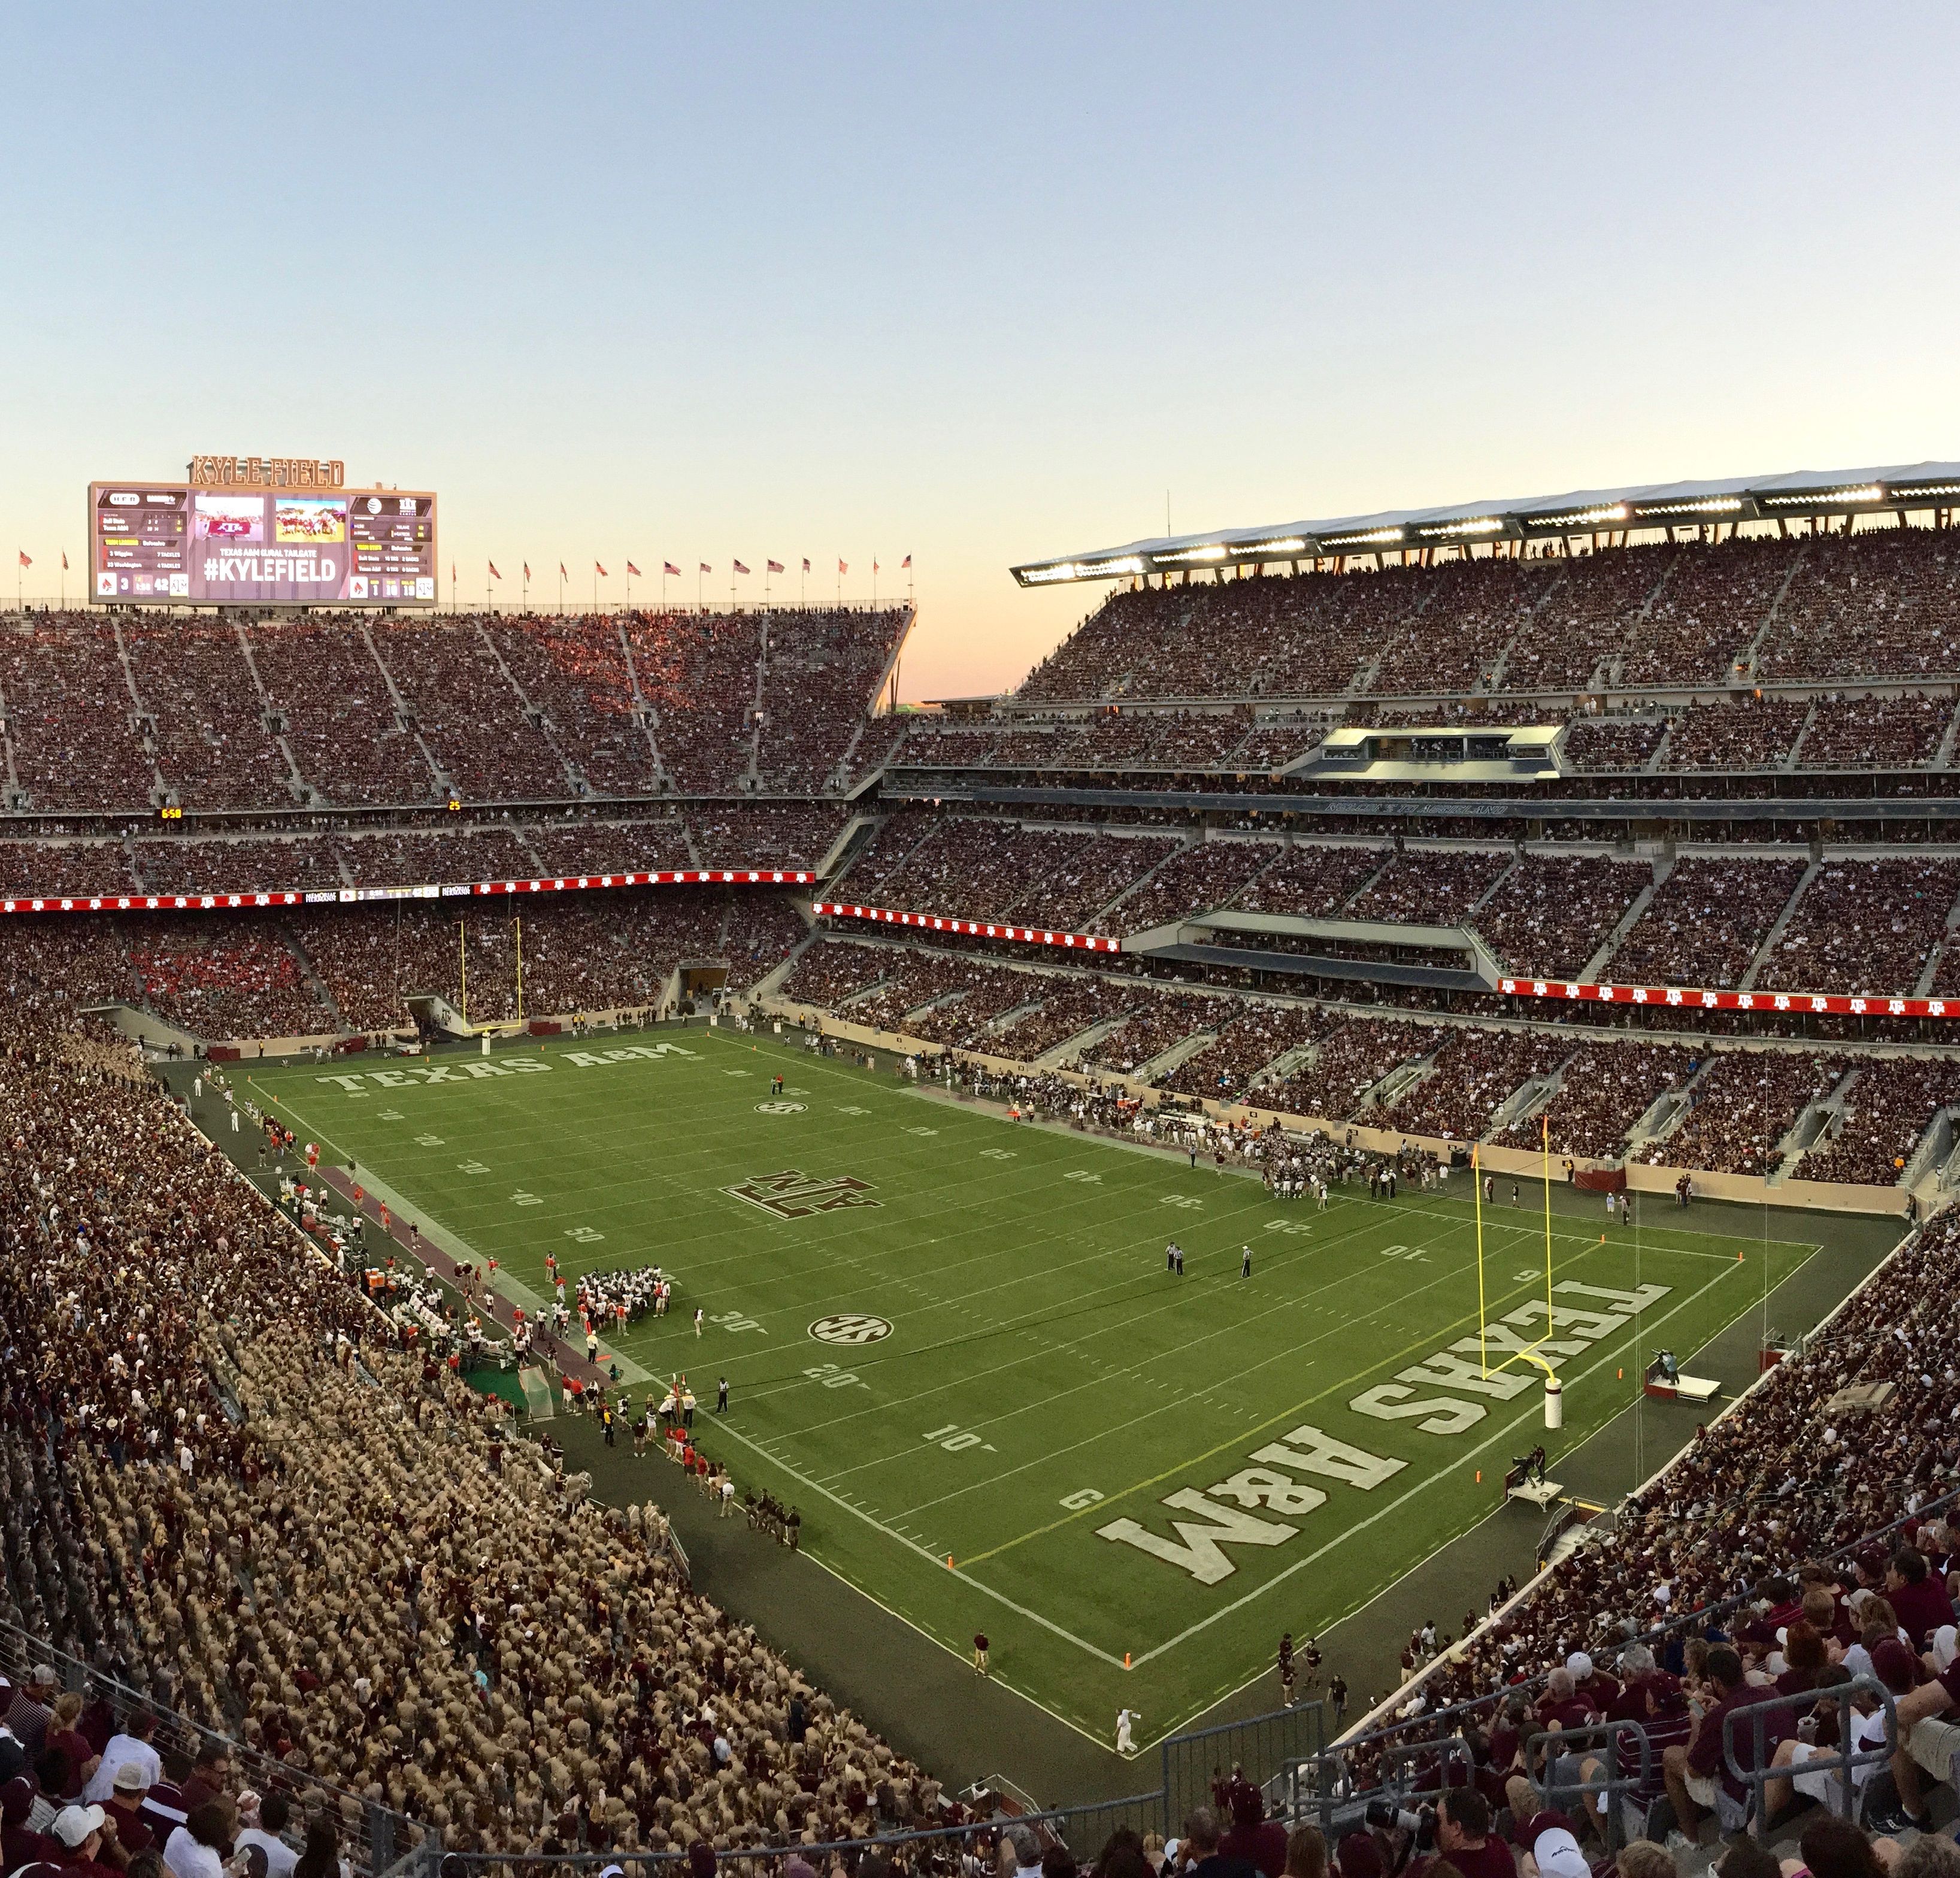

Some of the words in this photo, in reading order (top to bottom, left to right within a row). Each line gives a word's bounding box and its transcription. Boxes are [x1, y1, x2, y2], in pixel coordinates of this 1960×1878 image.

[192, 455, 262, 485] KYLE
[269, 458, 344, 488] FIELD
[219, 548, 243, 556] TEXAS
[284, 549, 317, 558] TAILGATE
[204, 558, 336, 582] #KYLEFIELD
[120, 577, 129, 590] 3
[154, 578, 169, 591] 42
[373, 584, 378, 596] 1
[449, 801, 461, 810] 25
[162, 808, 181, 819] 6:58
[358, 890, 364, 900] 3
[412, 887, 423, 897] 42
[315, 1058, 554, 1091] TEXAS
[560, 1043, 696, 1067] A&M
[376, 1111, 405, 1120] 10
[413, 1135, 446, 1146] 20
[979, 1148, 1018, 1160] 50
[456, 1162, 492, 1174] 30
[1063, 1170, 1102, 1183] 40
[508, 1194, 544, 1206] 40
[1158, 1195, 1203, 1208] 30
[1262, 1219, 1312, 1234] 20
[563, 1226, 605, 1243] 50
[1380, 1245, 1427, 1260] 10
[708, 1310, 760, 1332] 30
[1349, 1280, 1674, 1434] TEXAS
[801, 1364, 860, 1389] 20
[922, 1424, 982, 1452] 10
[1059, 1488, 1105, 1510] G
[1093, 1425, 1410, 1586] A&M
